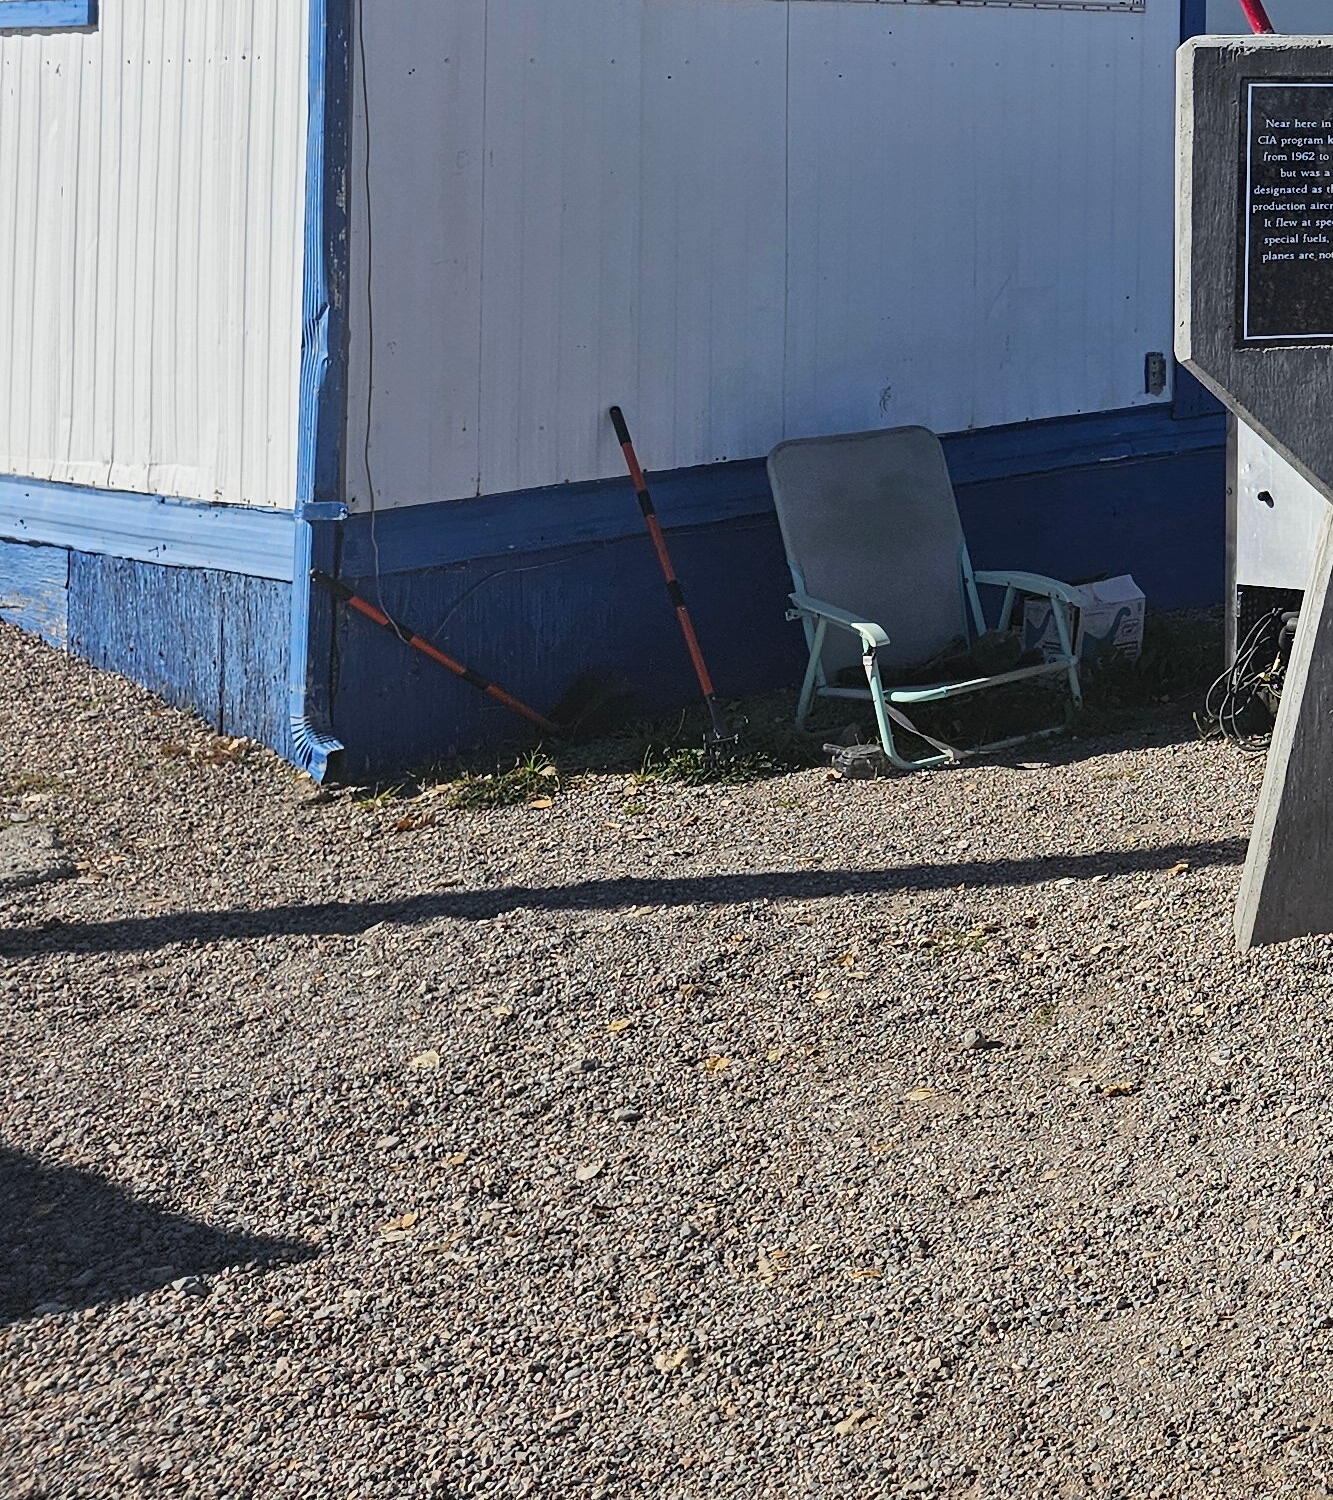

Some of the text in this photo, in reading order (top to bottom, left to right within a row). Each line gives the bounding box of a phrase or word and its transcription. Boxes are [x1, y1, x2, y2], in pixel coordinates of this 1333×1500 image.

[1265, 118, 1290, 128] Near
[1294, 118, 1317, 127] here
[1257, 135, 1277, 144] CIA
[1280, 137, 1323, 147] program
[1263, 151, 1287, 161] from
[1291, 151, 1315, 160] 1962
[1279, 167, 1296, 177] but
[1253, 183, 1307, 196] designated
[1252, 200, 1306, 213] production
[1264, 218, 1271, 227] It
[1275, 217, 1297, 226] flew
[1263, 233, 1298, 246] special
[1262, 250, 1294, 263] planes
[1318, 251, 1333, 259] not
